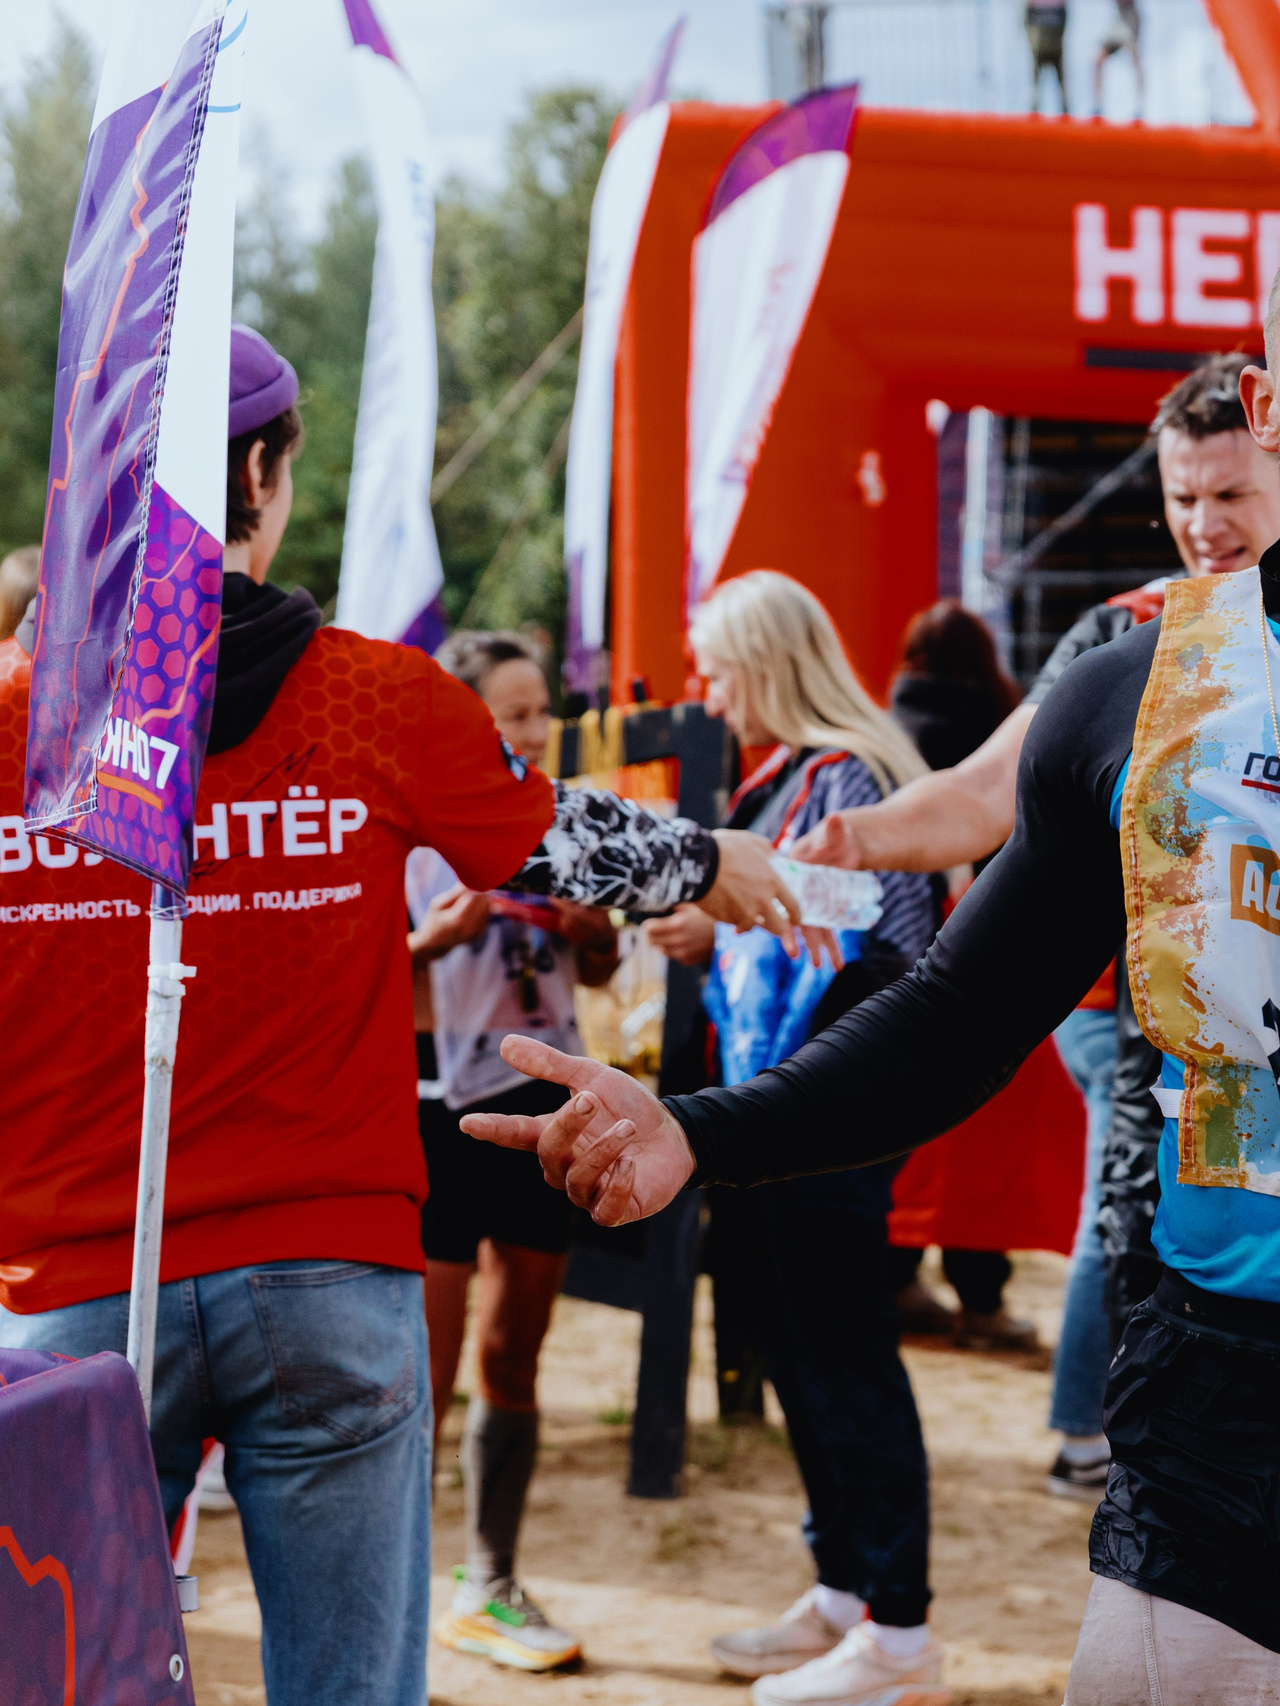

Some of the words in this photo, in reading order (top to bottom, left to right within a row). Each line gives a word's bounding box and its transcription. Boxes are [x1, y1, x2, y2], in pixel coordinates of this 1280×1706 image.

[0, 785, 369, 873] ВОНТЁР
[185, 893, 241, 916] ОЦИИ
[252, 882, 362, 911] ПОДДЕРЖКА
